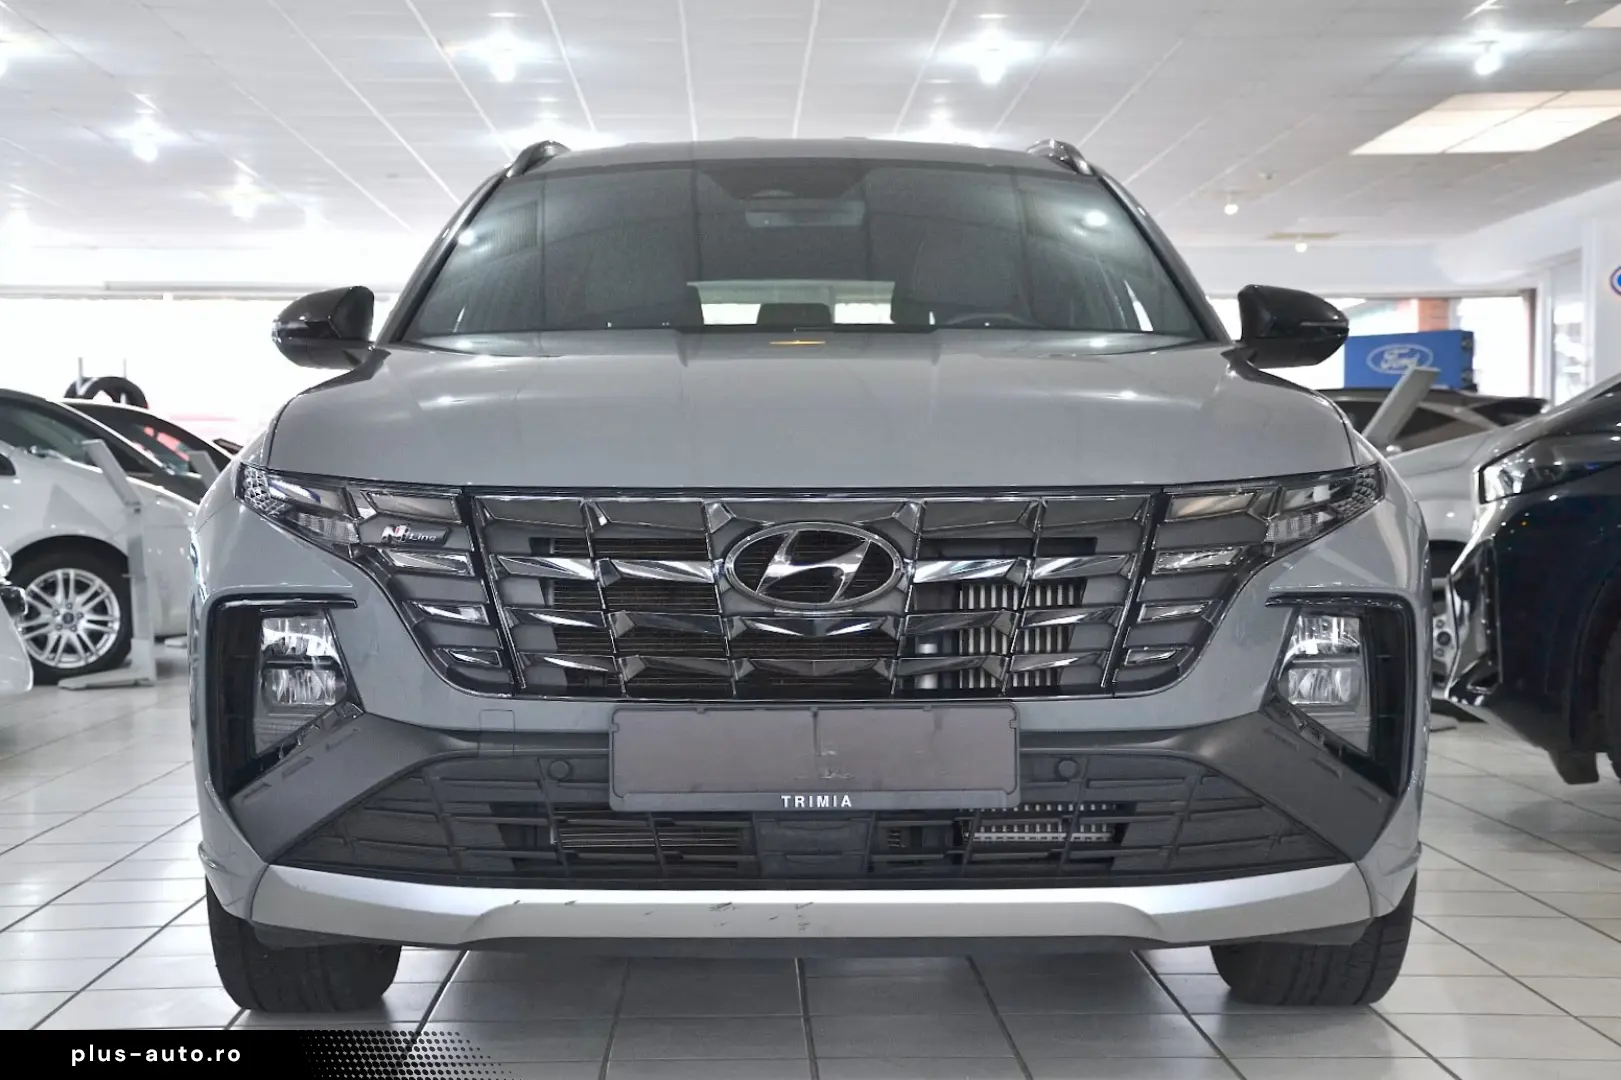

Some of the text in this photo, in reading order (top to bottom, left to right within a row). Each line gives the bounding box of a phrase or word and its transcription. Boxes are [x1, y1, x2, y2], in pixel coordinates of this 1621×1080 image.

[381, 524, 437, 543] N Line
[780, 795, 852, 808] TRIMIA
